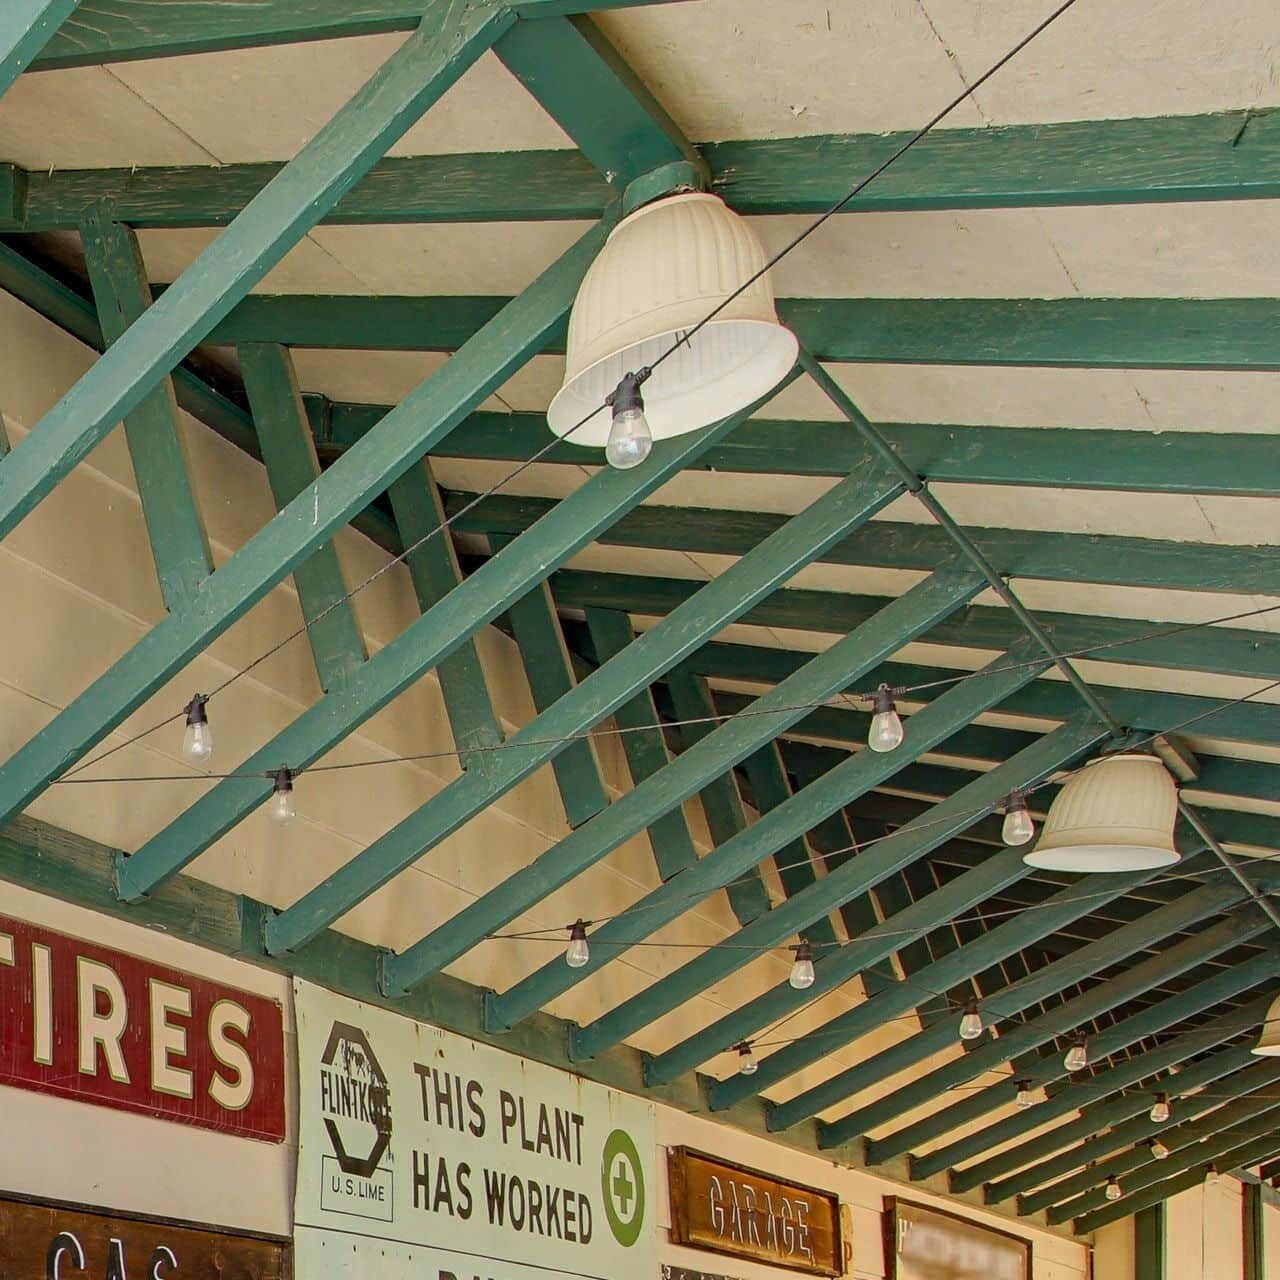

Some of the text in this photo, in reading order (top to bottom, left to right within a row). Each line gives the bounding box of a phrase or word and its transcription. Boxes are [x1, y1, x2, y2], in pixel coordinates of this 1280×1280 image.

[413, 1062, 585, 1166] THIS PLANT
[358, 1185, 385, 1202] LIME
[412, 1150, 593, 1246] HAS WORKED
[710, 1175, 812, 1260] GARAGE
